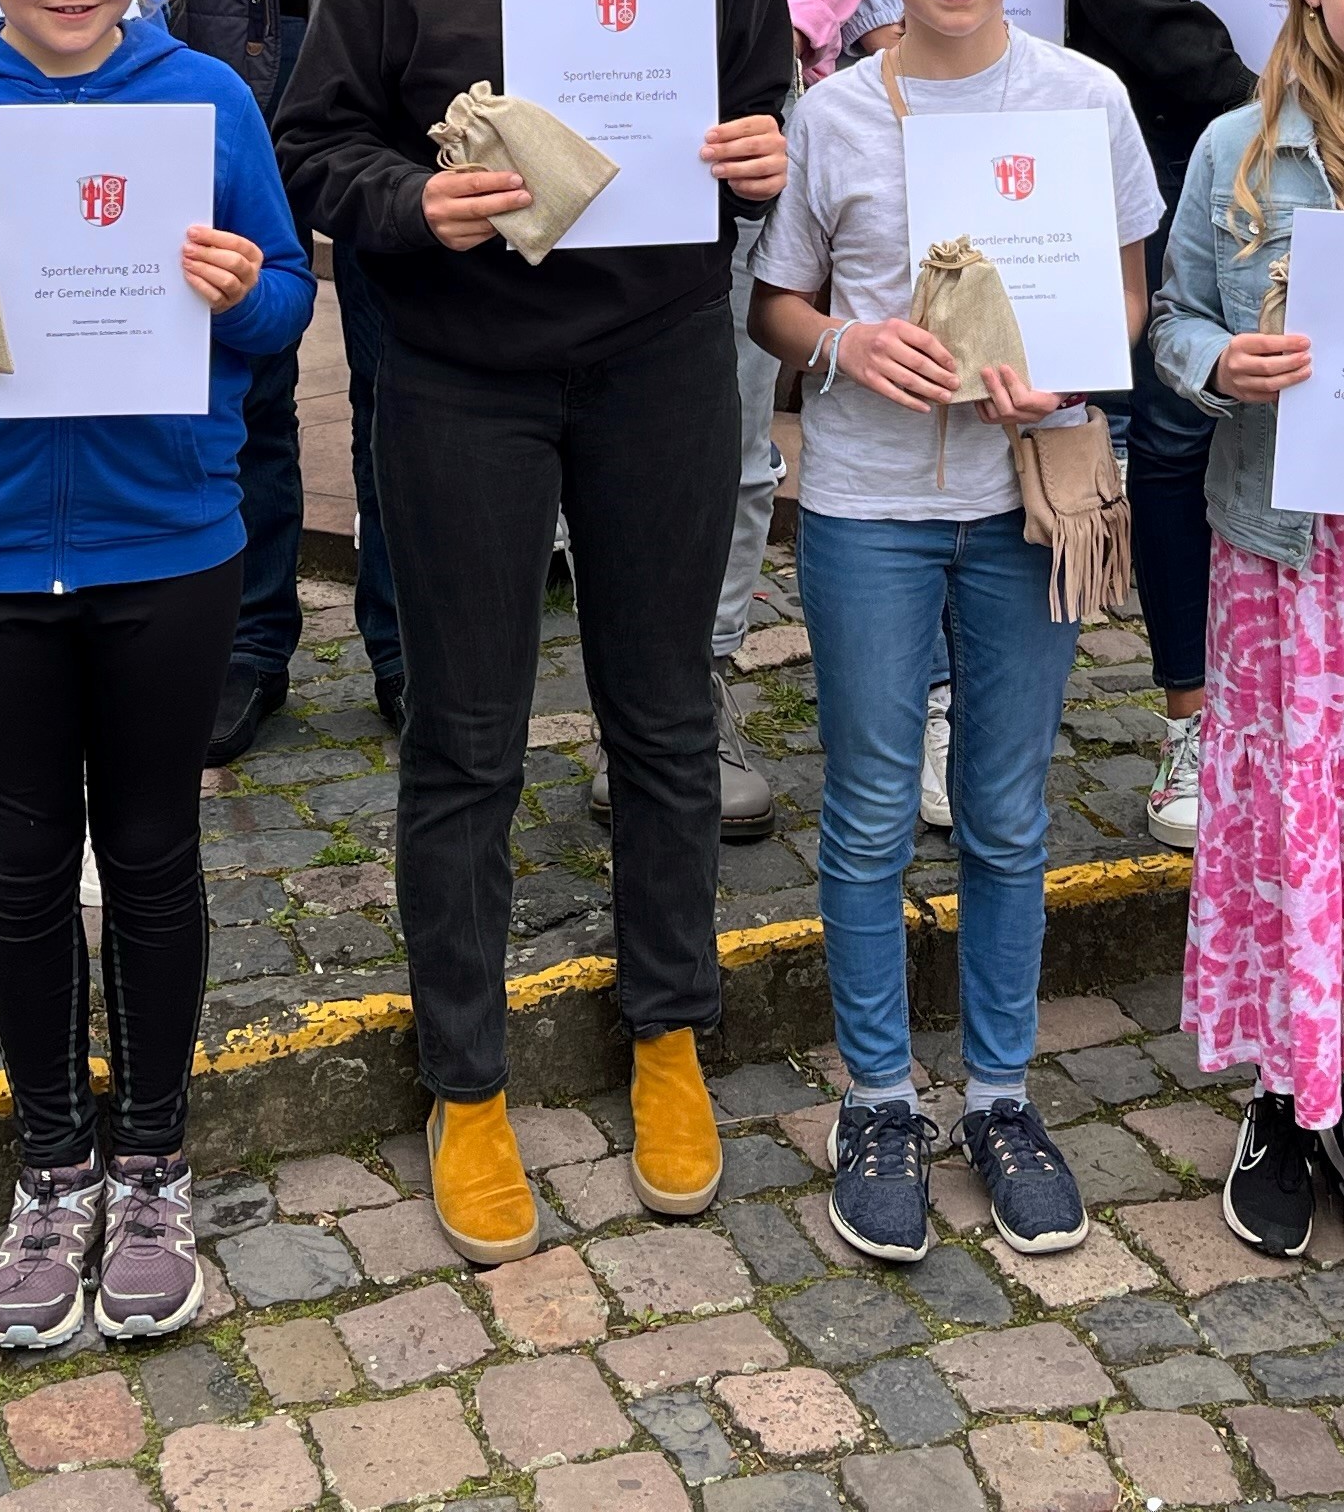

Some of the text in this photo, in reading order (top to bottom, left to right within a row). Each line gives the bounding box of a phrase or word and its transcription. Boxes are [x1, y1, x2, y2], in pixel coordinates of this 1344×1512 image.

[563, 68, 671, 82] Sportlerehrung 2023
[558, 90, 677, 103] der Gemeinde Kiedrich
[971, 232, 1073, 247] portlerehrung 2023
[1037, 252, 1080, 264] Kiedrich
[41, 263, 160, 278] Sportlerehrung 2023
[34, 285, 166, 299] der Gemeinde Kiedrich
